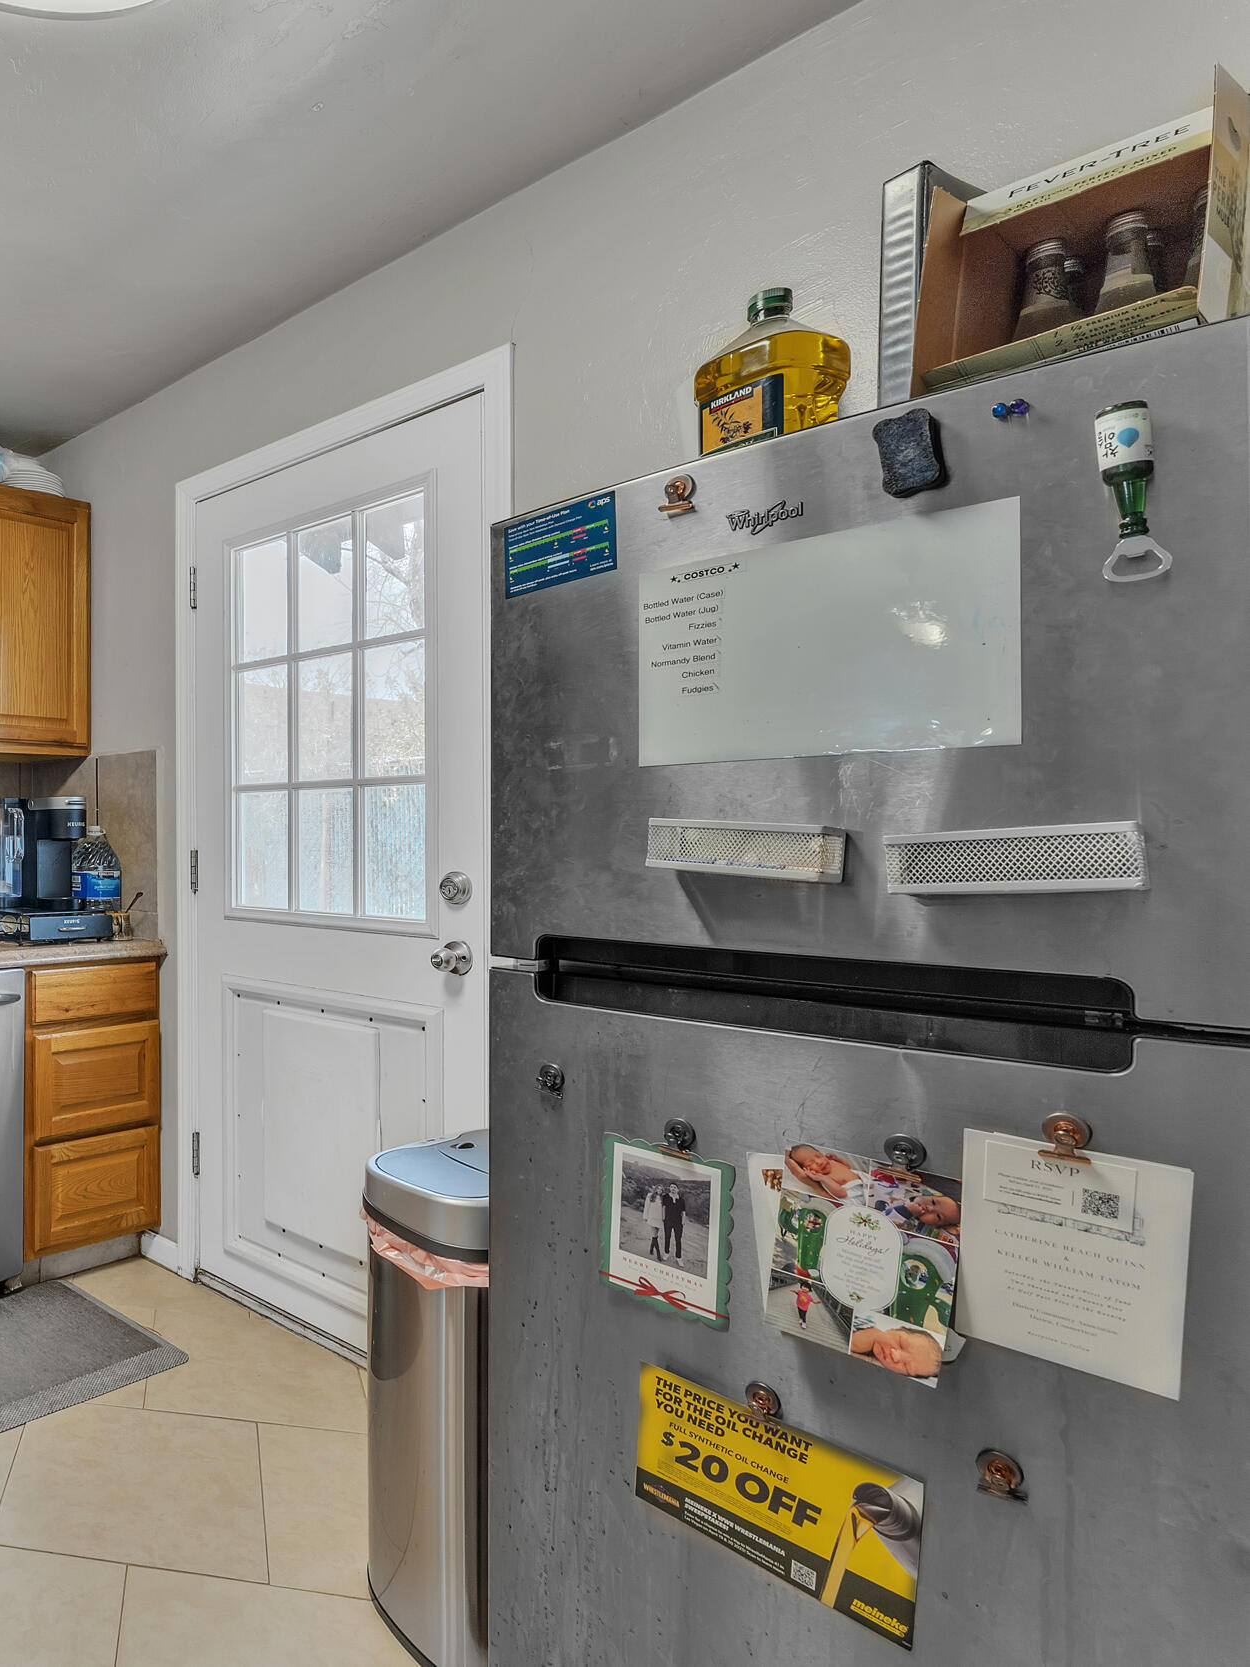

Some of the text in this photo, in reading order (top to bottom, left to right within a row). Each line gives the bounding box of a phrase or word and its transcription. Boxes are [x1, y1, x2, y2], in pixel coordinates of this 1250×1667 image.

[1007, 124, 1190, 199] FEVER-TREE
[710, 386, 752, 409] KIRKLAND
[597, 497, 611, 506] aps
[726, 500, 804, 535] Whirlpool
[684, 566, 725, 580] COSTCO
[643, 589, 724, 611] Bottled Water (Case)
[645, 604, 719, 624] Bottled Water (Jug)
[688, 621, 717, 631] Fizzies
[662, 637, 717, 651] Vitamin Water
[651, 653, 716, 669] Normandy Blend
[681, 668, 715, 679] Chicken
[681, 684, 714, 695] Fudgies
[1031, 1160, 1080, 1177] RSVP
[654, 1385, 808, 1465] FOR THE OIL CHANGE
[655, 1374, 812, 1454] THE PRICE YOU WANT
[655, 1397, 725, 1439] YOU NEED
[668, 1420, 789, 1485] FULL SYNTHETIC OIL CHANGE
[660, 1427, 729, 1489] $20
[734, 1465, 822, 1538] OFF
[642, 1481, 680, 1508] WRESTLEMANIA
[684, 1496, 712, 1515] MEINEKE
[716, 1513, 734, 1528] WWE
[733, 1523, 787, 1557] WRESTLEMANIA
[852, 1598, 908, 1633] meineke
